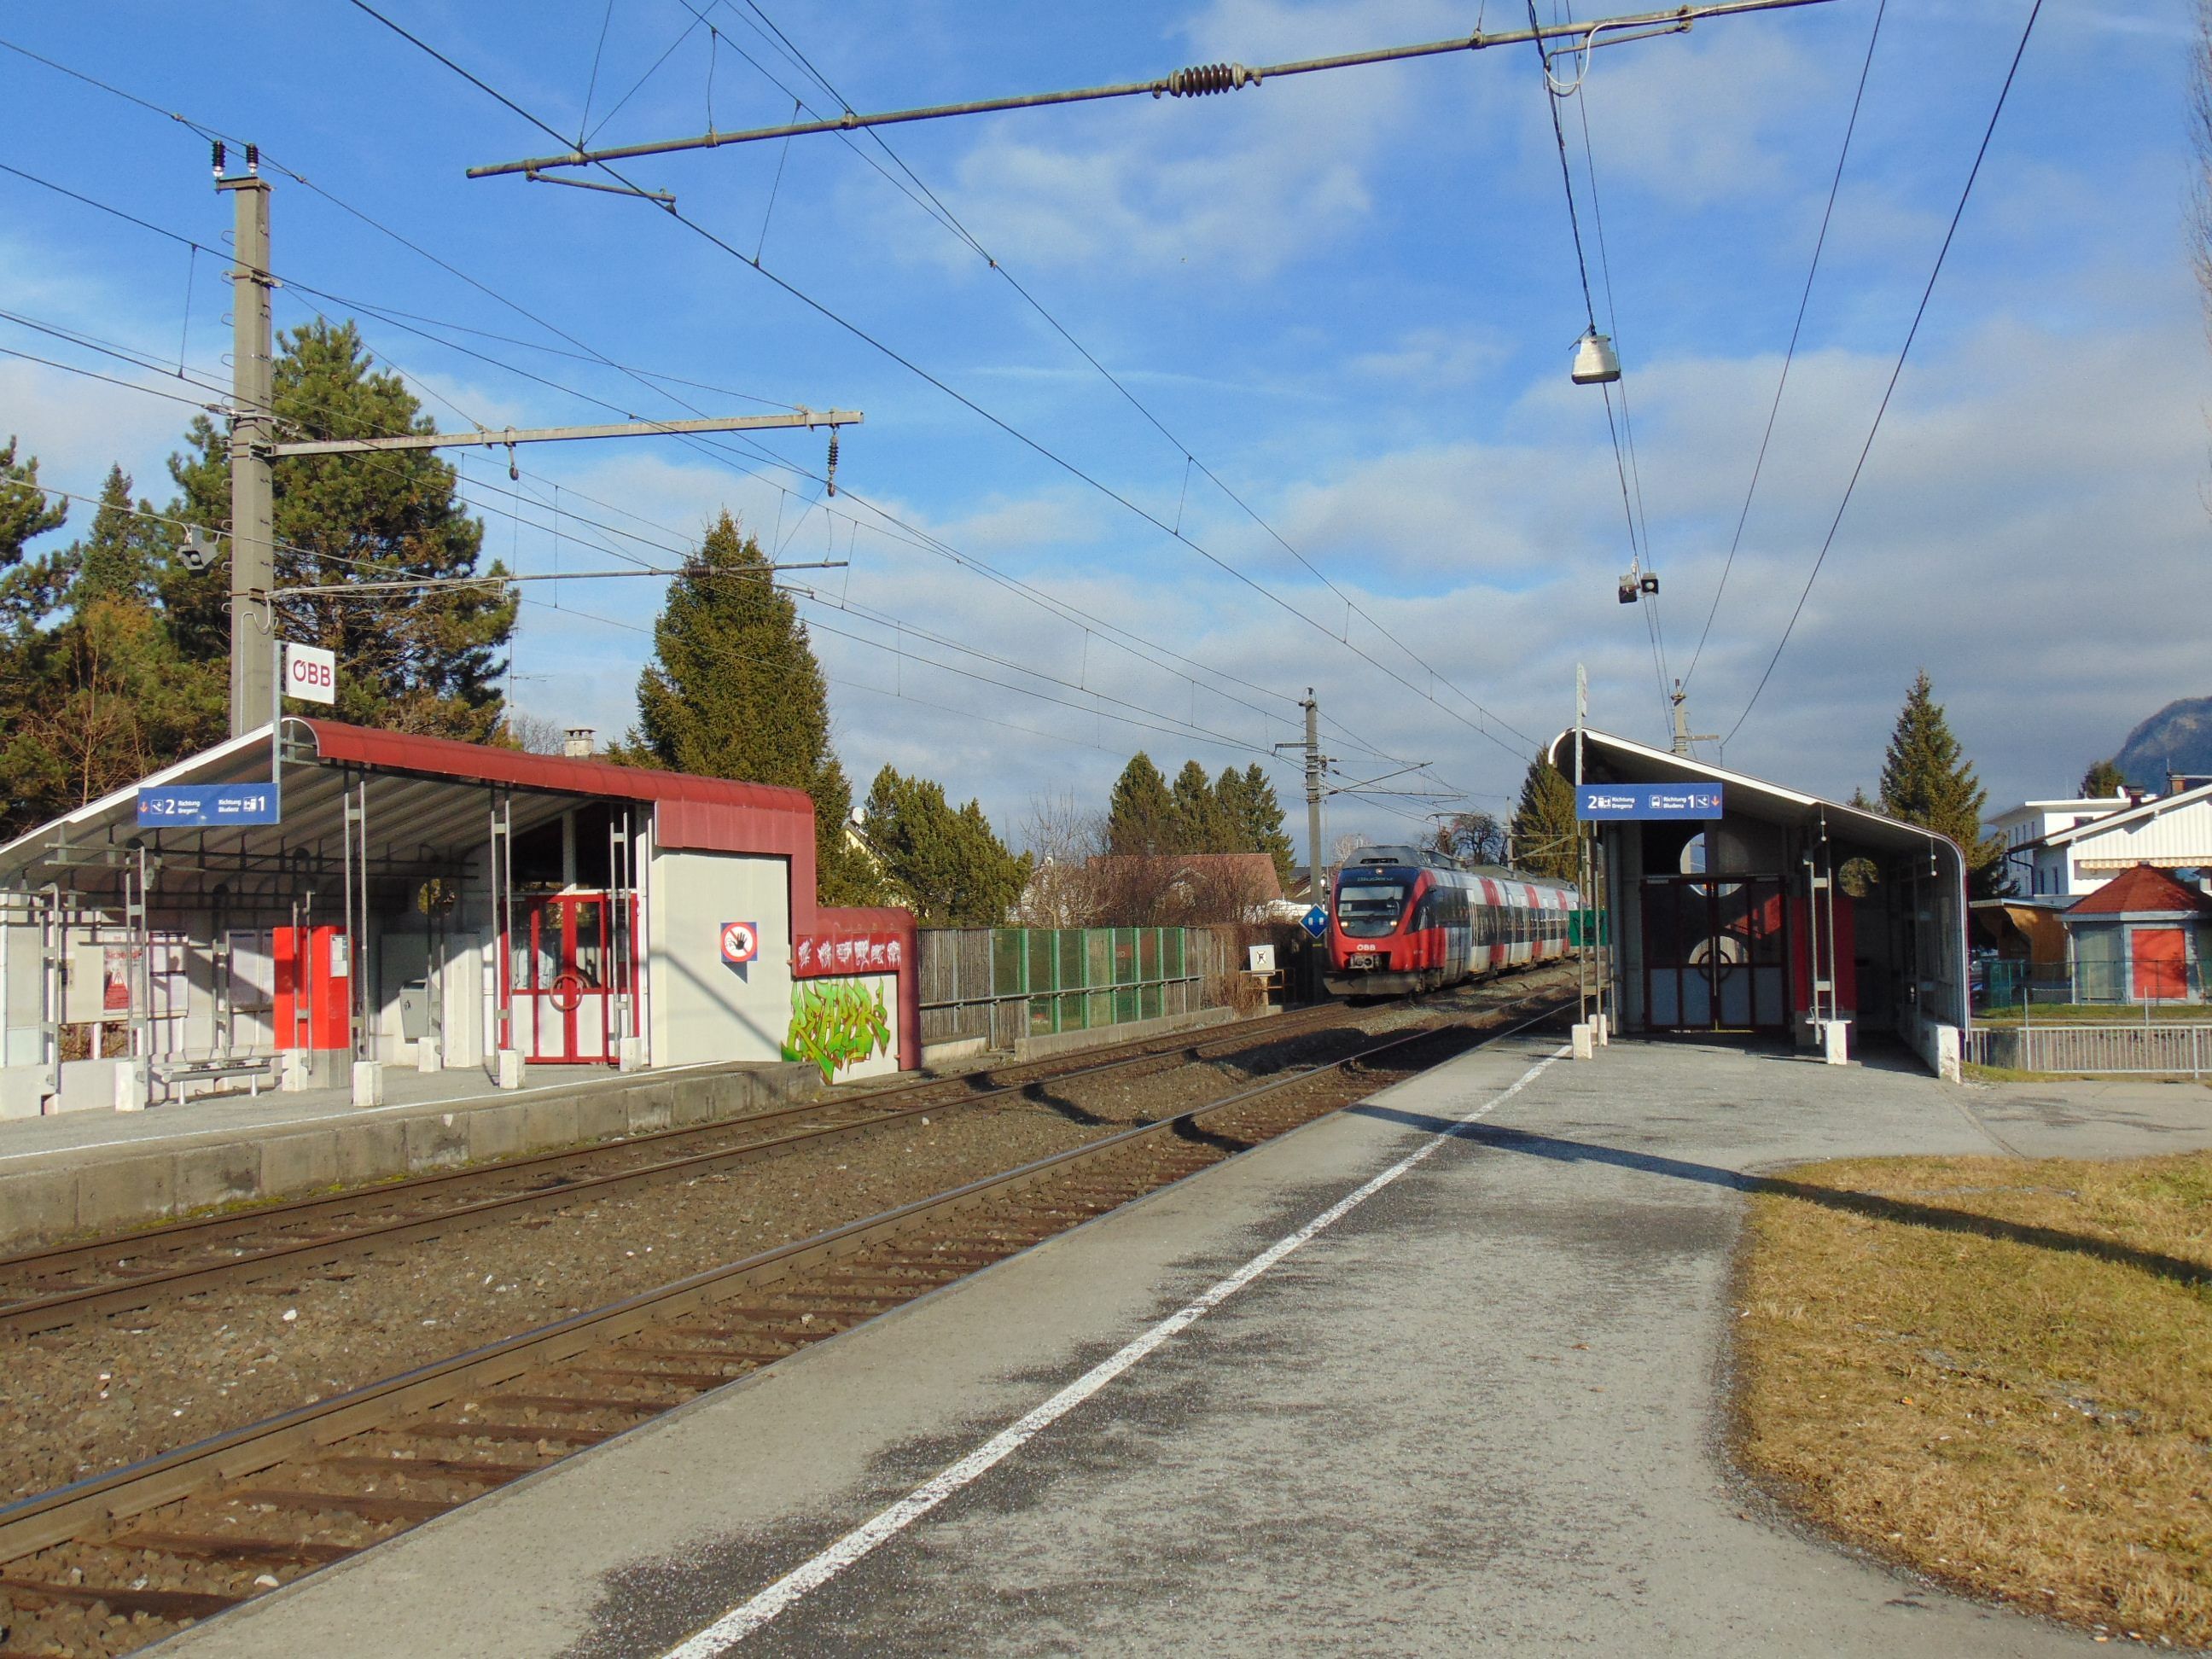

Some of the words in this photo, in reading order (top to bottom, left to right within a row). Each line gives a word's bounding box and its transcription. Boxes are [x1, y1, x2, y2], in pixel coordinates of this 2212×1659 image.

[165, 799, 176, 814] 2
[258, 795, 265, 812] 1
[1587, 795, 1598, 809] 2
[1688, 795, 1695, 809] 1
